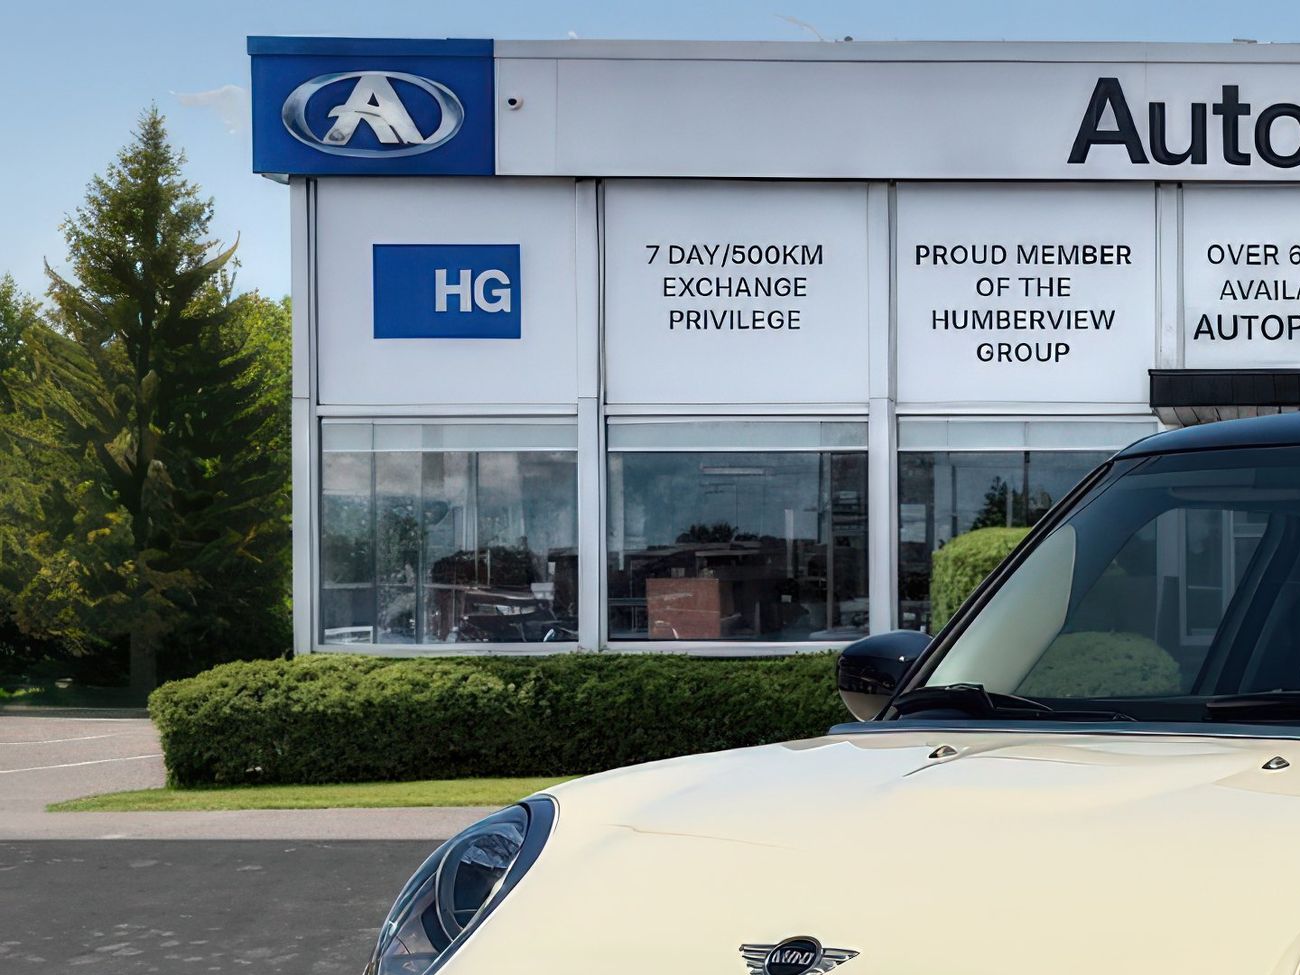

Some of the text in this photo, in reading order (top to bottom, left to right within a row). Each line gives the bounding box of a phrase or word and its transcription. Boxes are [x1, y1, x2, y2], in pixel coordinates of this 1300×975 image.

[645, 244, 824, 267] 7 DAY/500KM
[915, 244, 1132, 266] PROUD MEMBER
[1207, 243, 1280, 266] OVER
[433, 268, 512, 314] HG
[663, 276, 807, 298] EXCHANGE
[976, 276, 1071, 298] OF THE
[669, 309, 801, 330] PRIVILEGE
[932, 309, 1116, 330] HUMBERVIEW
[976, 342, 1070, 363] GROUP
